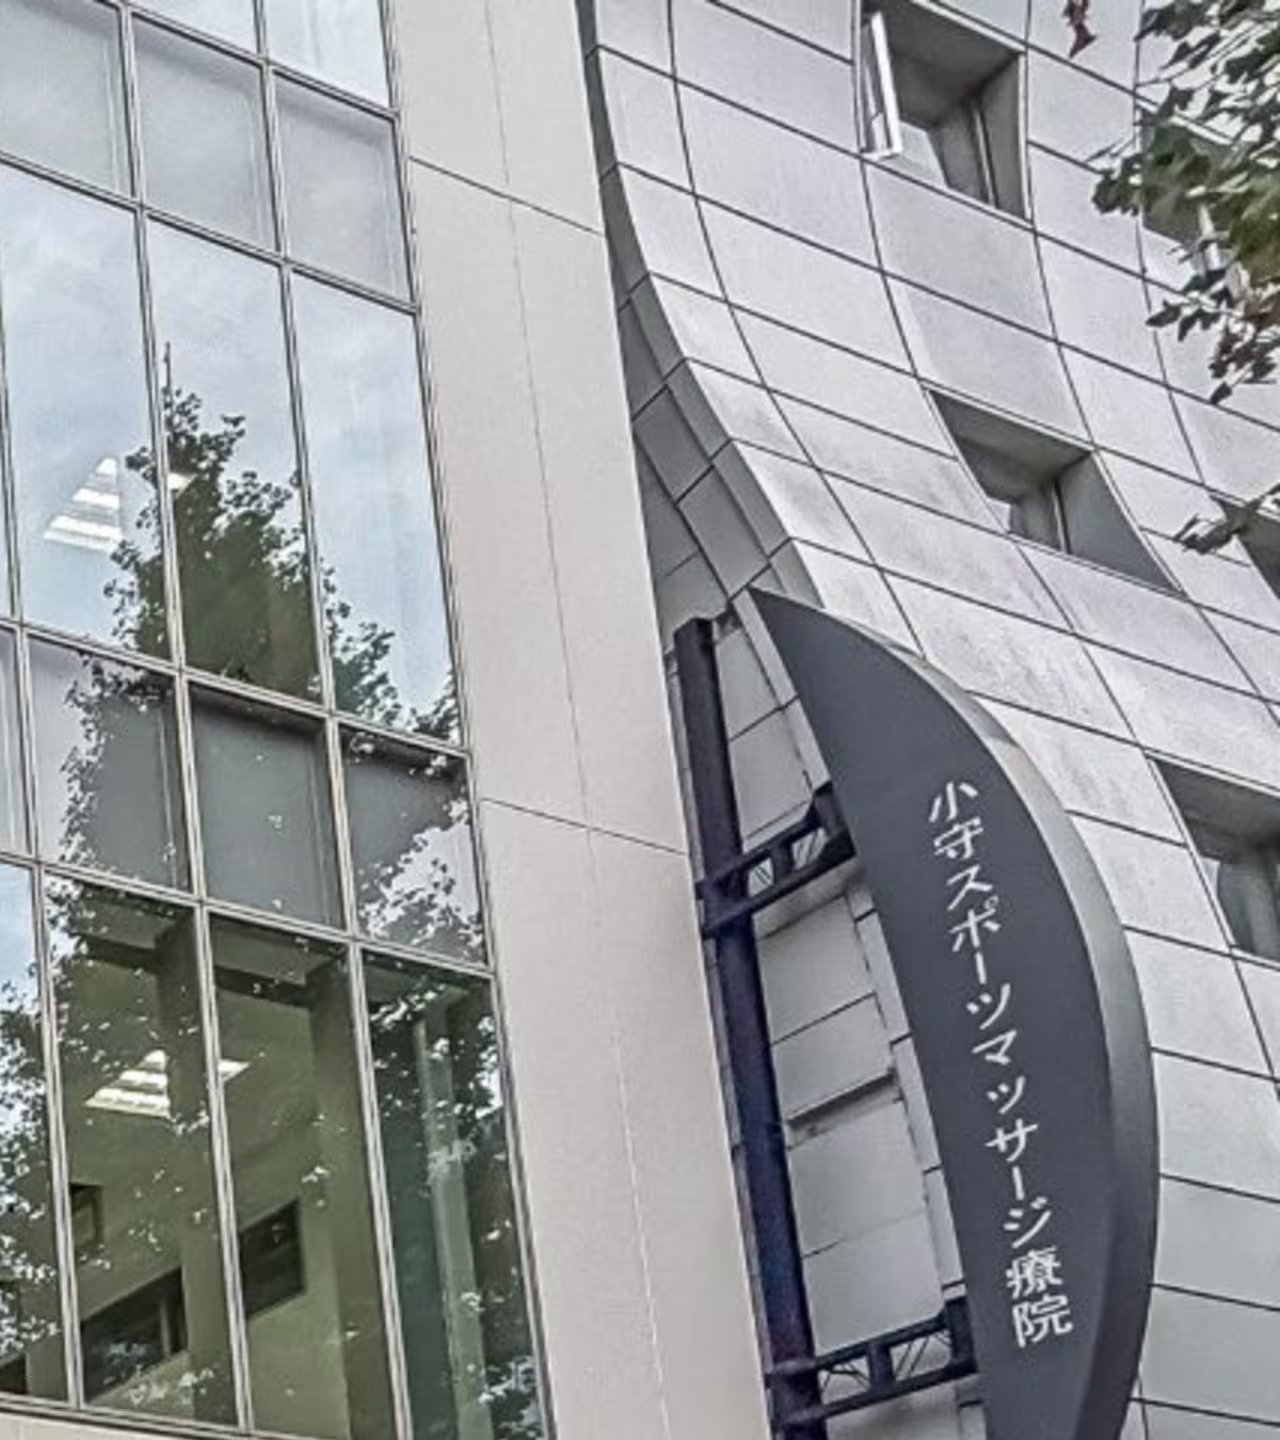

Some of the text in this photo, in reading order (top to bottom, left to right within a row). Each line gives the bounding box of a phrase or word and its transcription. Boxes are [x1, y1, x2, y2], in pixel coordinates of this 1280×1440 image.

[929, 782, 1073, 1348] 小守スポーツマッサージ療院
